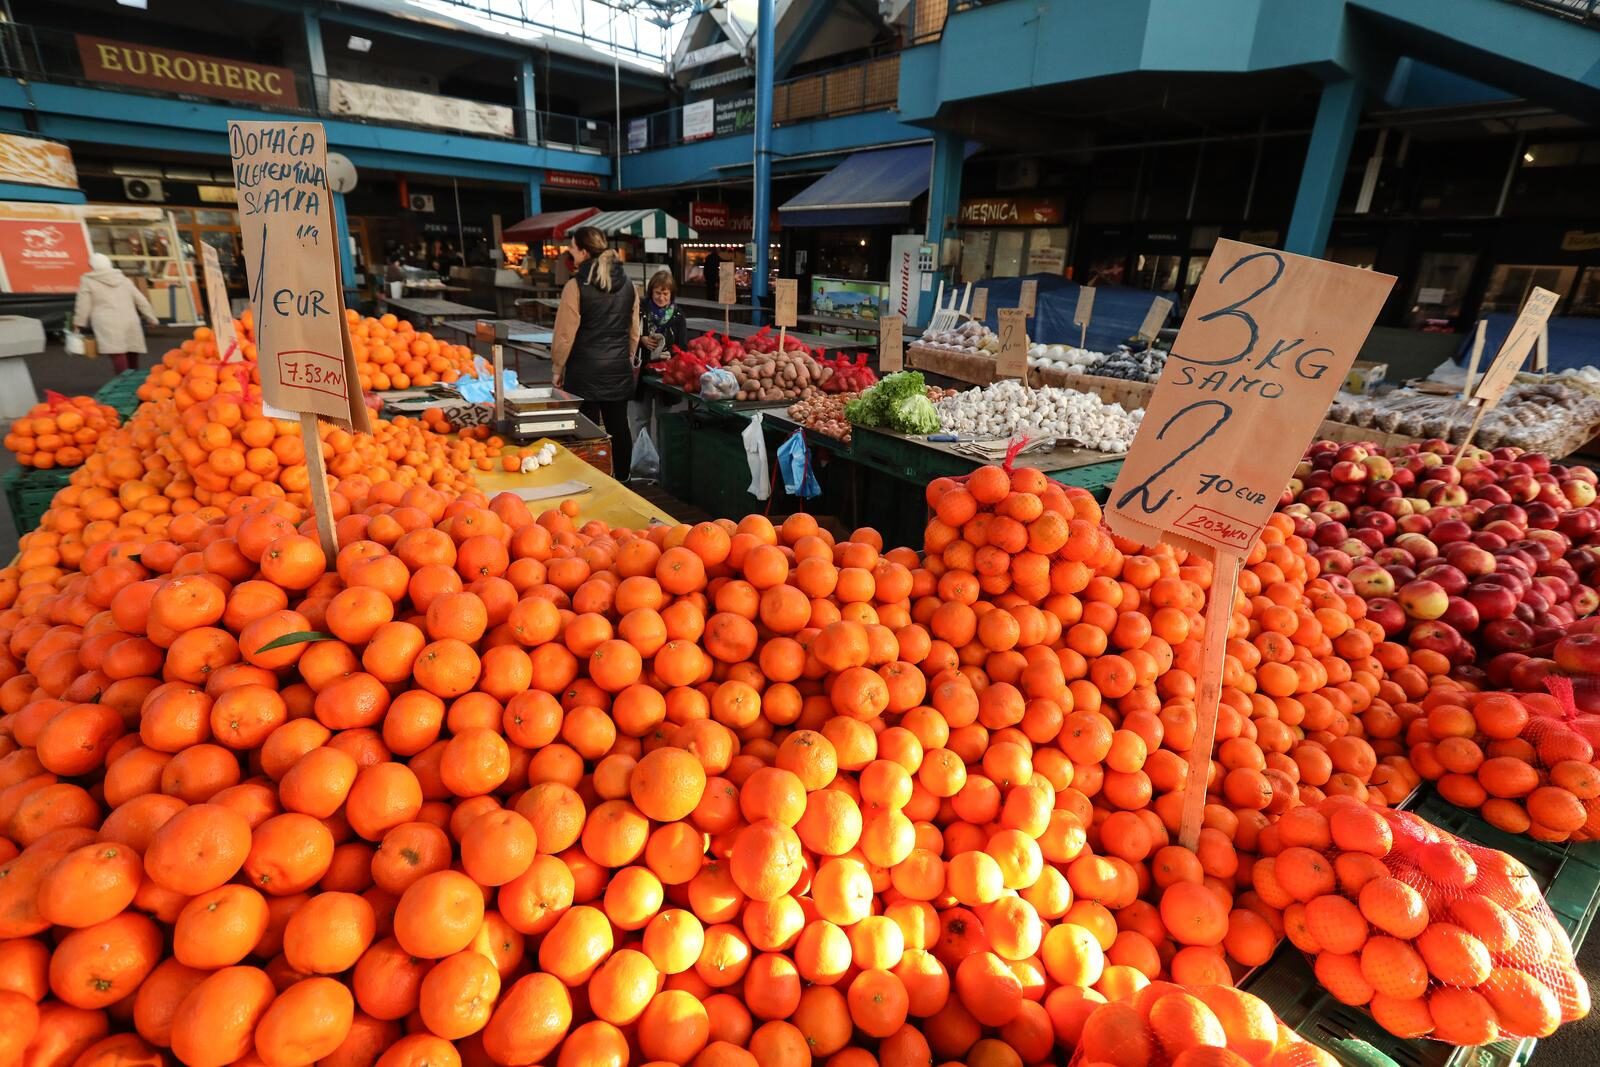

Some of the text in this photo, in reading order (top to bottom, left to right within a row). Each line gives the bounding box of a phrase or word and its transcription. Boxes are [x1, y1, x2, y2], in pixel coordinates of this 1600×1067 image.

[96, 43, 283, 95] EUROHERC
[230, 124, 315, 160] DOMAĆA
[273, 288, 330, 317] EUR
[897, 251, 912, 318] Jamnica
[1172, 366, 1284, 398] SAMO
